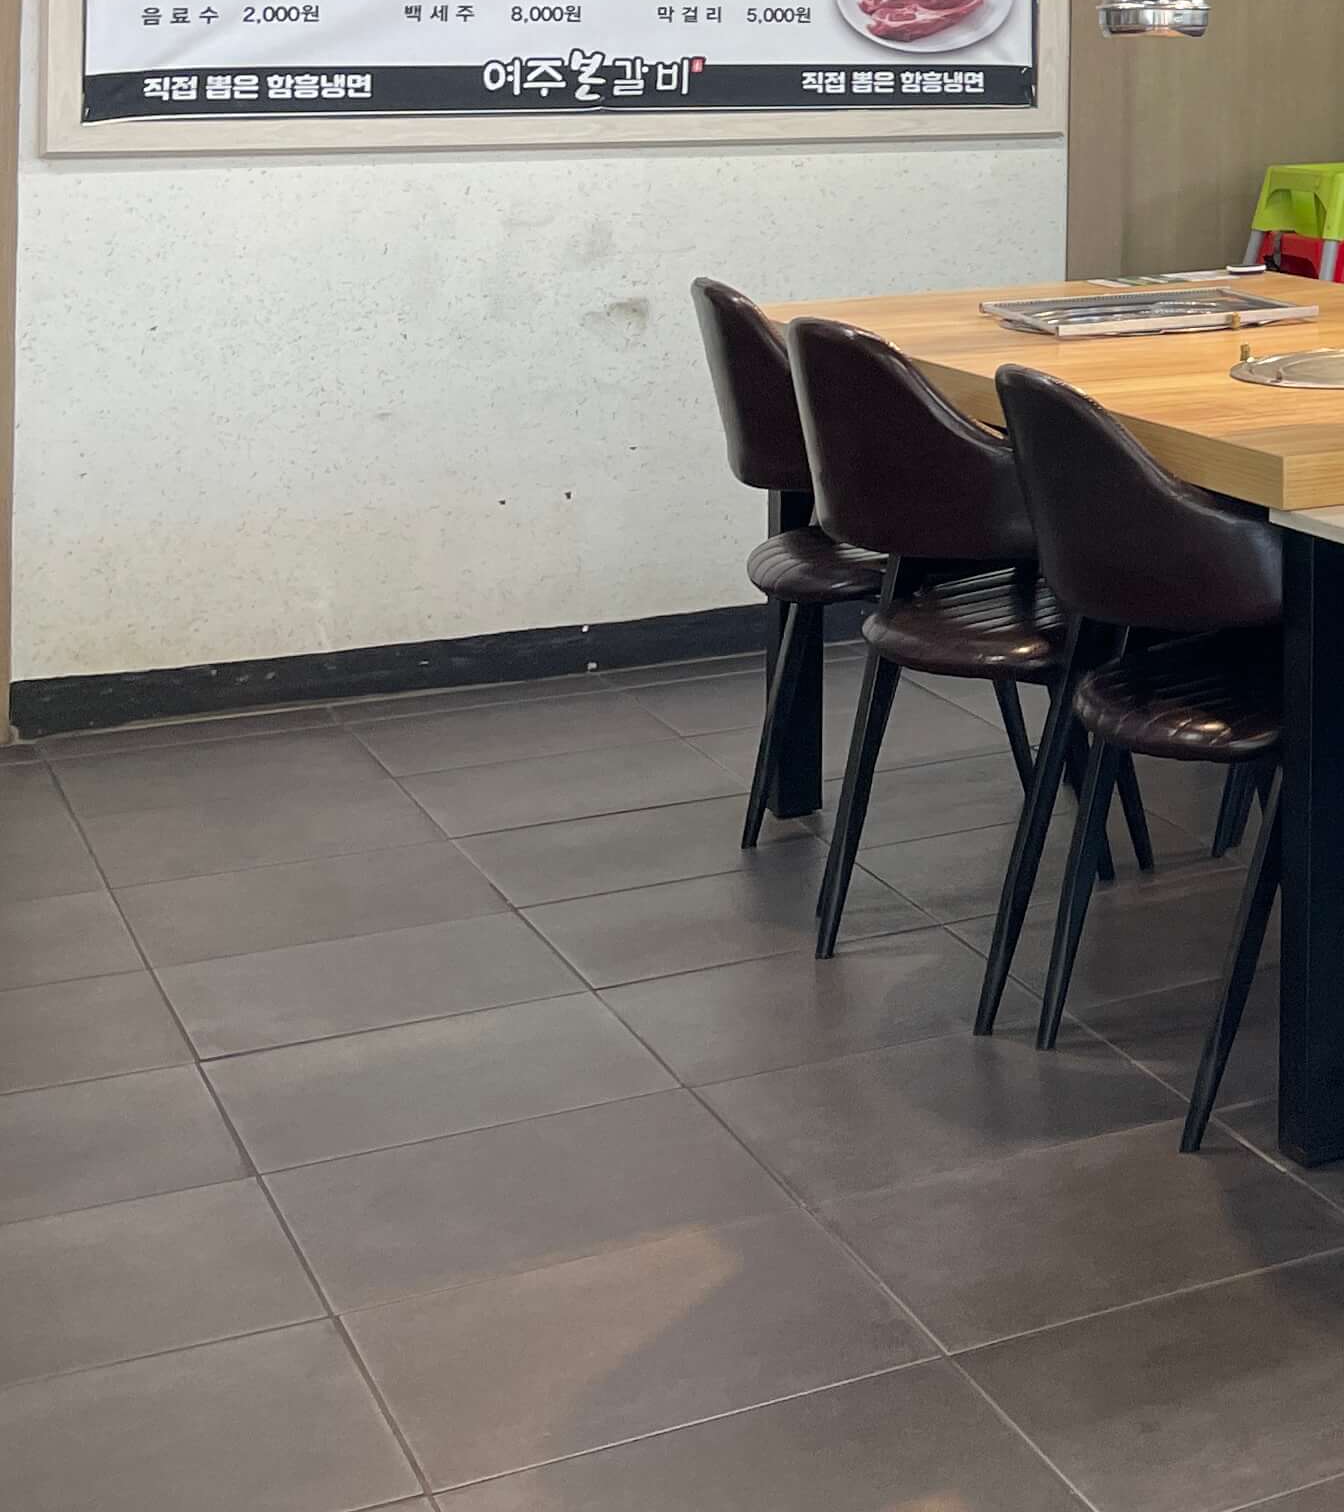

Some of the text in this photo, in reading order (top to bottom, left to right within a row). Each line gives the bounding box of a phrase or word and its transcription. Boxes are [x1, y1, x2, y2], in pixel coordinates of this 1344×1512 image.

[243, 5, 319, 23] 2,000원
[512, 6, 581, 23] 8,000원
[747, 7, 810, 24] 5,000원
[143, 73, 373, 100] 직접 뽑은 함흥냉면
[802, 71, 984, 94] 직접 뽑은 함흥냉면
